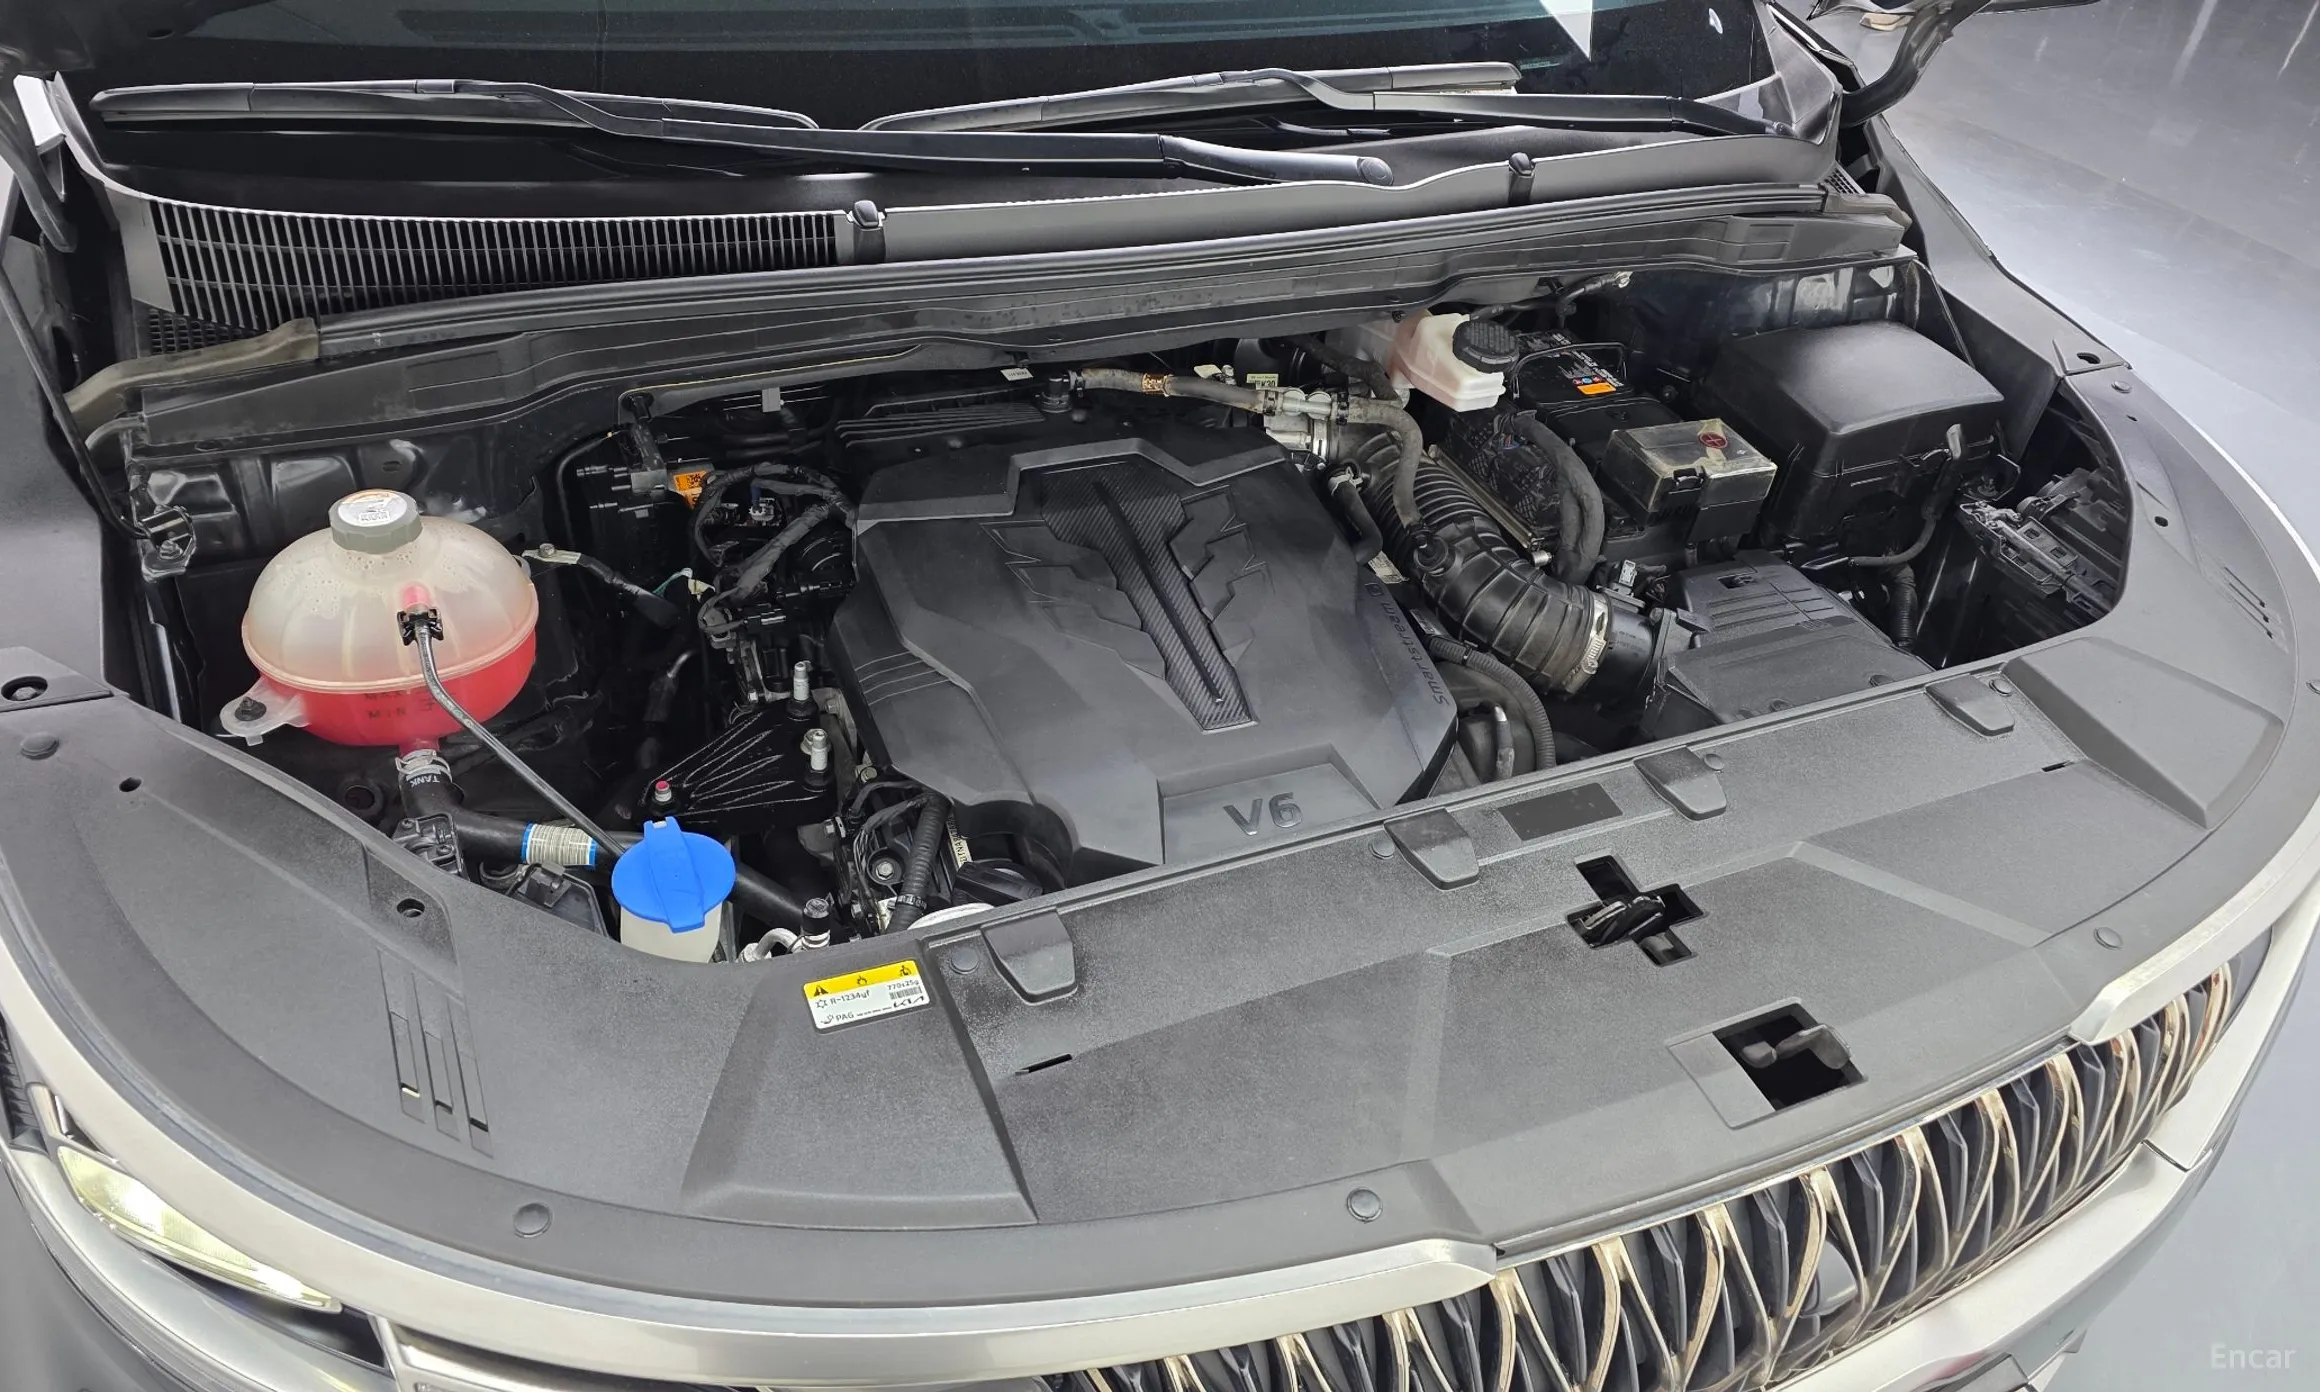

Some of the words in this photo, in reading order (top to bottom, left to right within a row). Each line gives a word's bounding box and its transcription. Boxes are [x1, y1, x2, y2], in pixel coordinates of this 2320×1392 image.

[1380, 602, 1450, 707] Smartstream
[410, 774, 441, 788] TANK
[1222, 791, 1303, 836] V6
[830, 990, 870, 1005] R-1234yf
[835, 1012, 855, 1022] PAG
